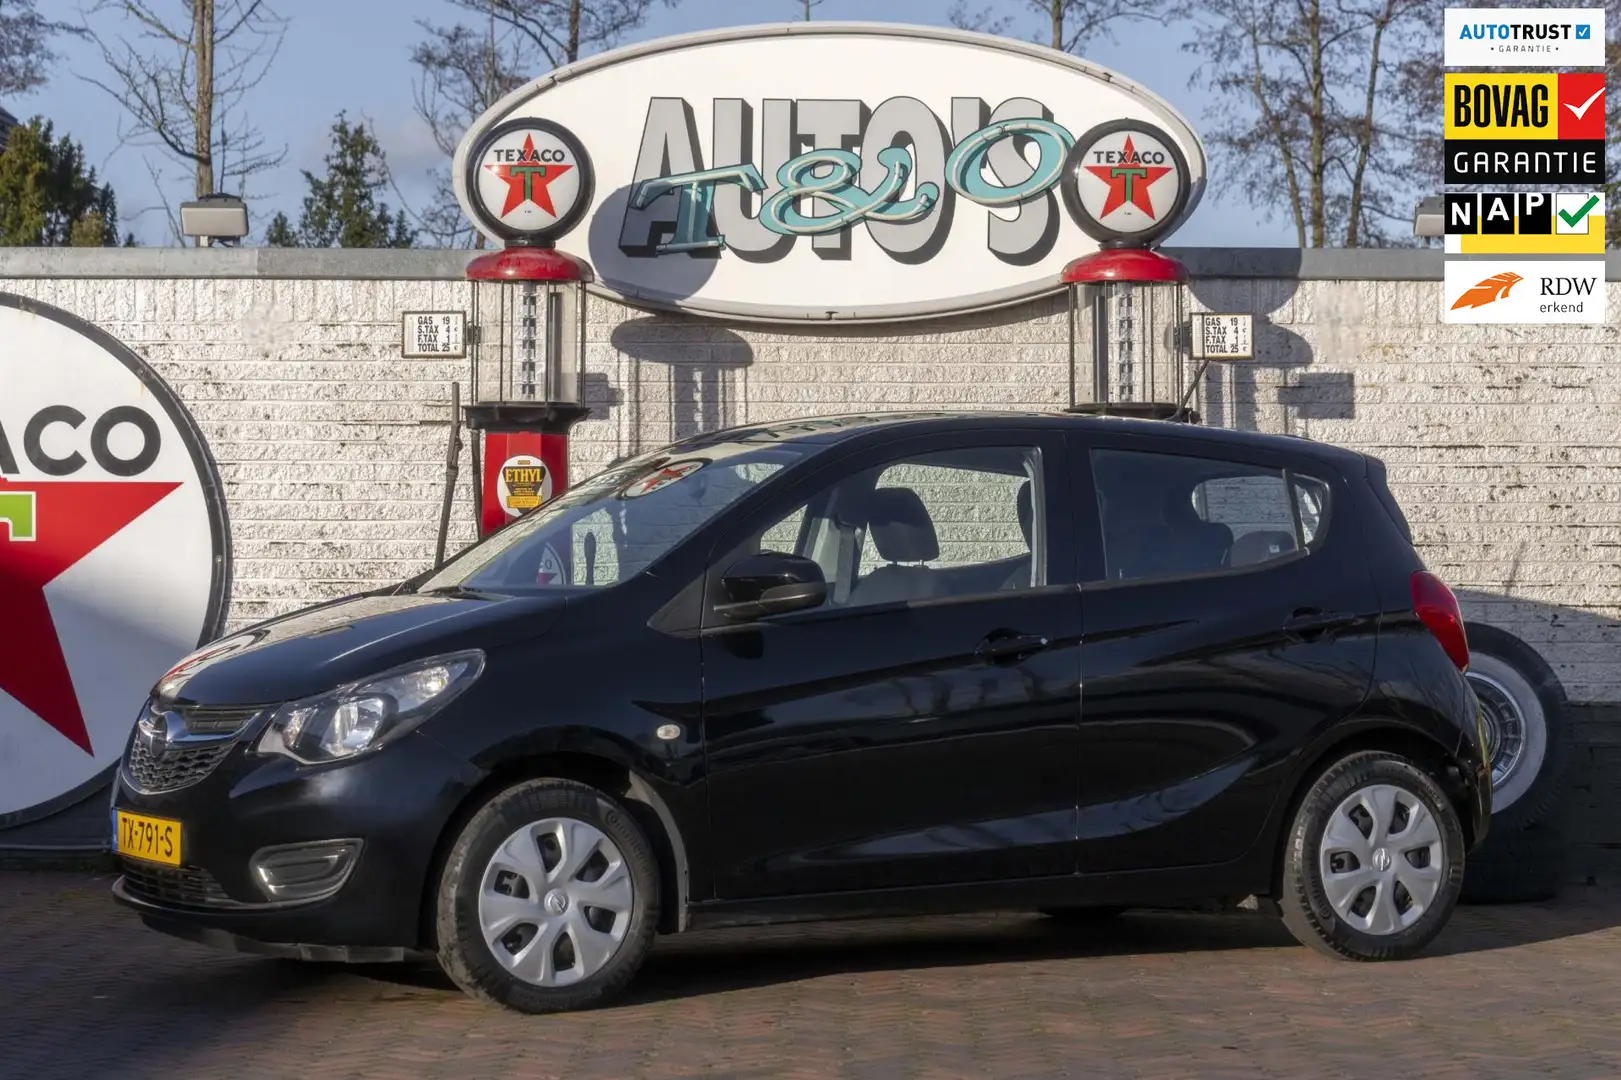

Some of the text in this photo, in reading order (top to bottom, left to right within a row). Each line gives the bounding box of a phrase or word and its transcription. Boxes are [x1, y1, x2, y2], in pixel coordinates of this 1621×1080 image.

[493, 149, 566, 163] TEXACO
[1093, 151, 1165, 164] TEXACO
[417, 316, 450, 325] GAS 19
[1205, 317, 1239, 326] GAS 19
[417, 325, 439, 334] S.TAX
[1205, 326, 1227, 335] S.TAX
[417, 343, 440, 352] TOTAL
[1205, 344, 1239, 353] TOTAL 25
[0, 404, 162, 477] CO
[505, 468, 543, 483] ETHYL
[121, 817, 173, 858] TX-791-S
